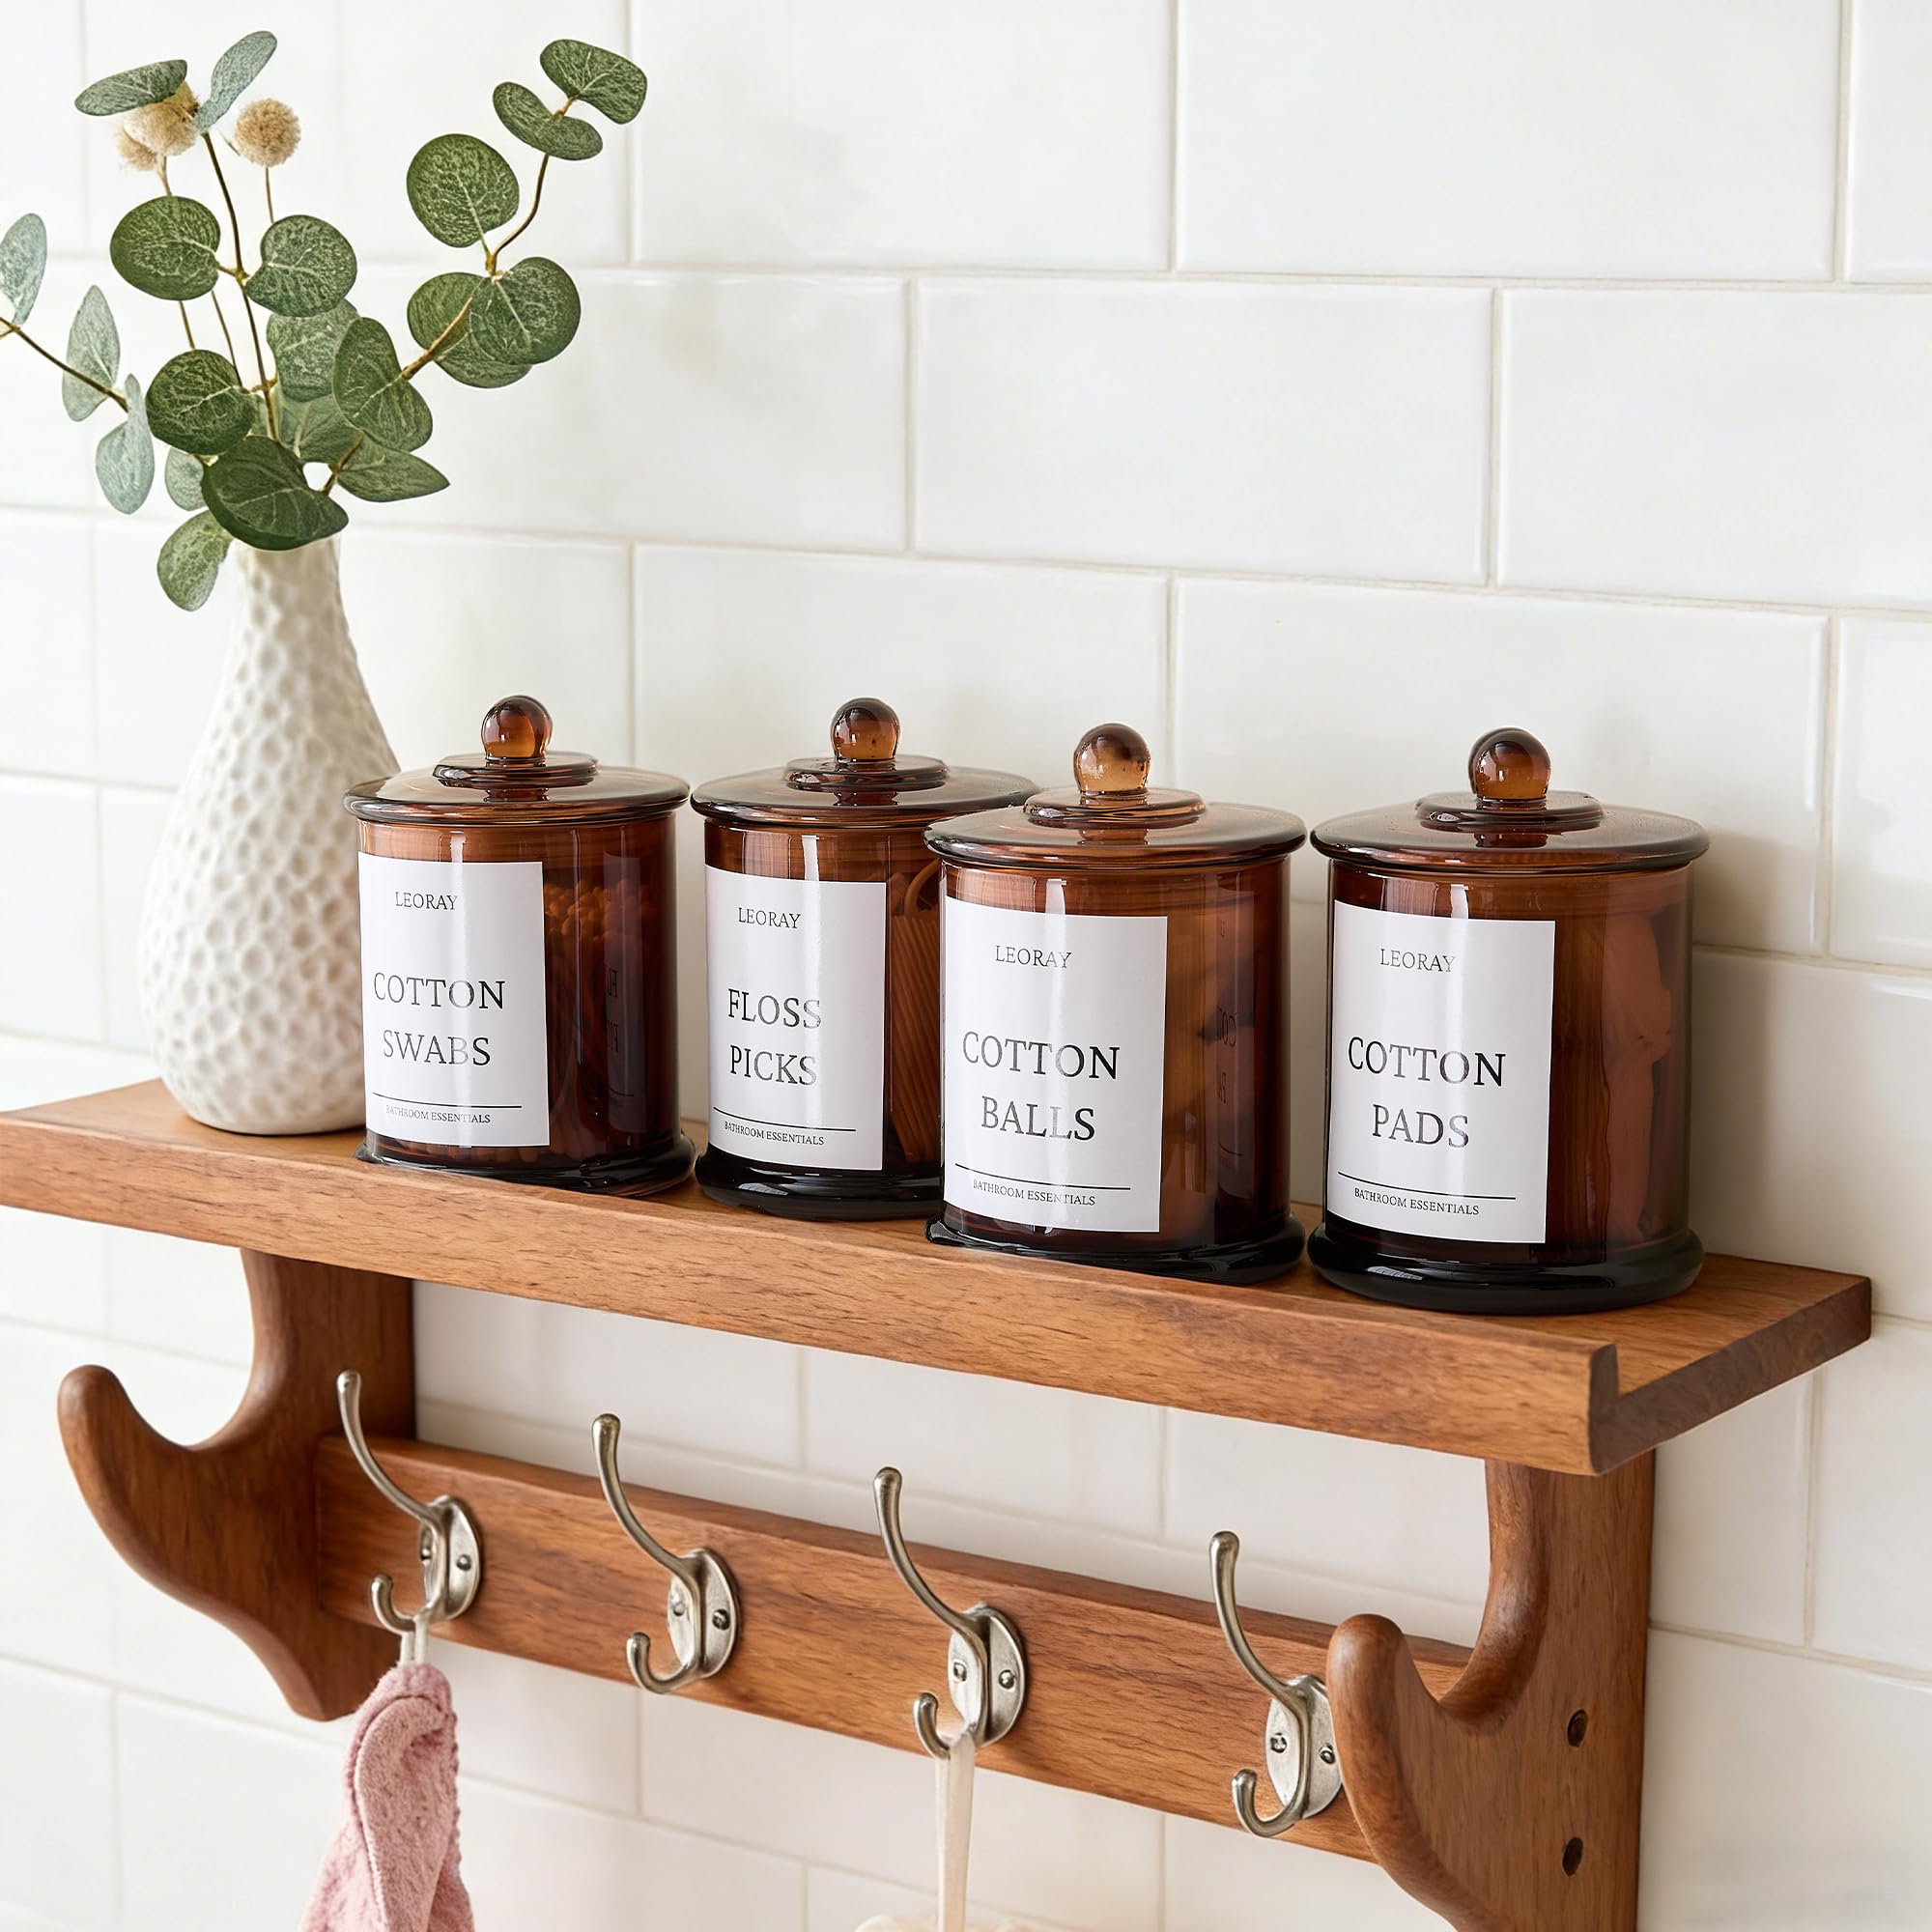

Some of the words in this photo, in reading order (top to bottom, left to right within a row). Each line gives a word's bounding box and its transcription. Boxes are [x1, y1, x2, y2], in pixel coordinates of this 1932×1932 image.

[396, 892, 457, 911] LEORAY
[738, 907, 801, 928] LEORAY
[995, 944, 1072, 968] LEORAY
[1379, 949, 1456, 973] LEORAY
[374, 973, 505, 1009] COTTON
[728, 988, 821, 1029] FLOSS
[384, 1030, 491, 1065] SWABS
[962, 1032, 1120, 1079] COTTON
[1349, 1037, 1506, 1087] COTTON
[730, 1045, 817, 1086] PICKS
[385, 1105, 429, 1121] BATHROOM
[431, 1112, 491, 1123] ESSENTIALS
[981, 1095, 1095, 1141] BALLS
[1373, 1104, 1469, 1149] PADS
[724, 1121, 764, 1139] BATHROOM
[766, 1131, 825, 1146] ESSENTIALS
[973, 1179, 1024, 1200] BATHROOM
[1027, 1190, 1095, 1206] ESSENTIALS
[1354, 1187, 1406, 1208] BATHROOM
[1409, 1199, 1480, 1216] ESSENTIALS
